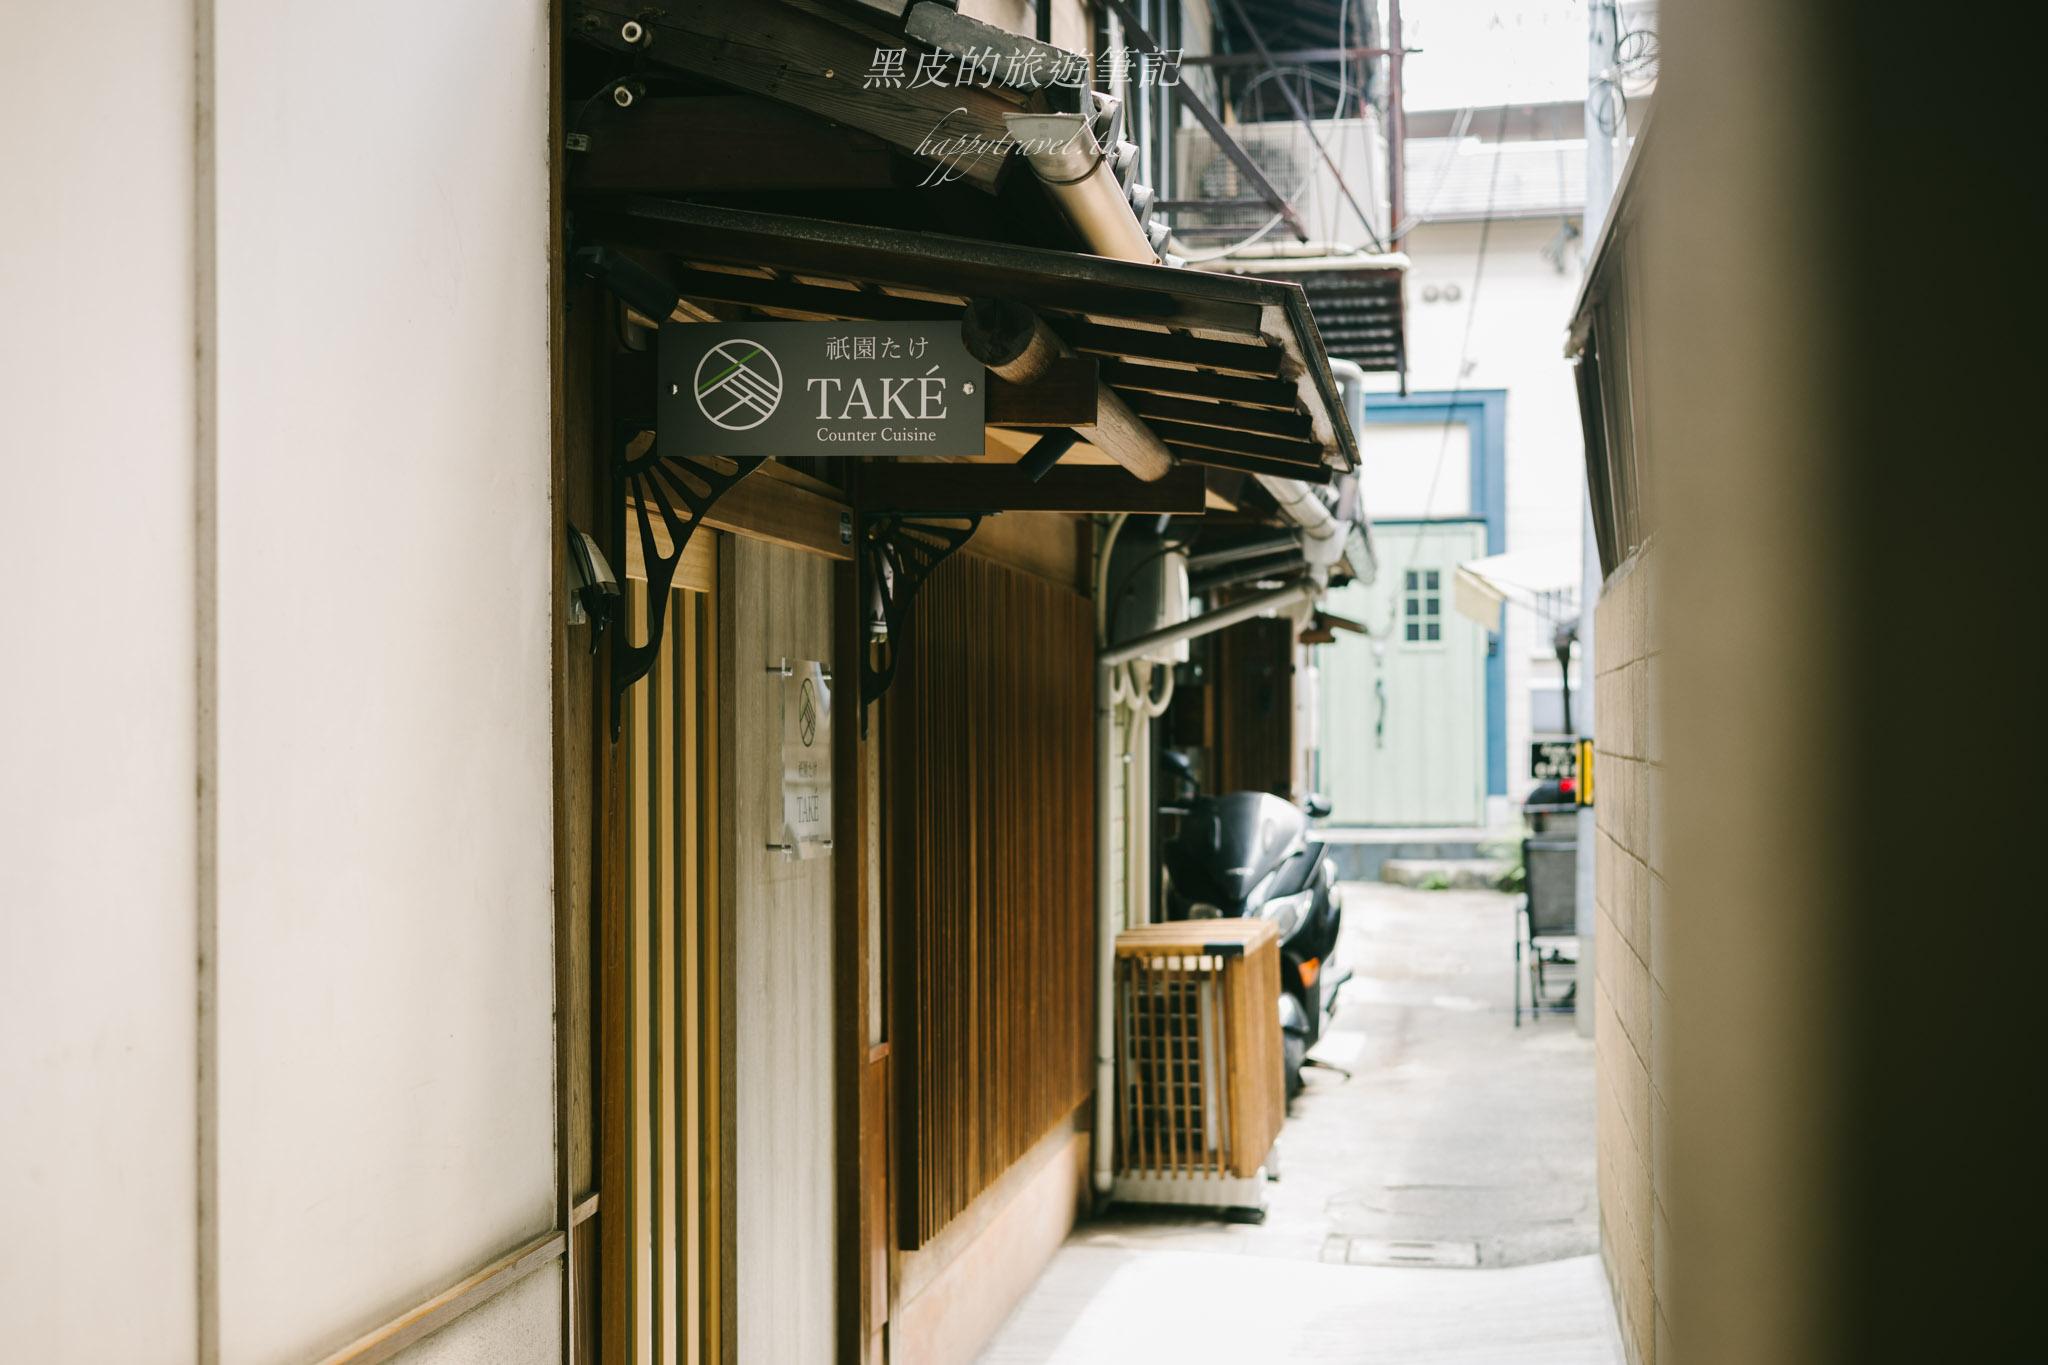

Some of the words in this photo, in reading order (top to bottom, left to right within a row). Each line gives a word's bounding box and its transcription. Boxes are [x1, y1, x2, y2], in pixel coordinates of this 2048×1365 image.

[826, 336, 928, 360] 祇園たけ
[807, 364, 947, 419] TAKÉ
[816, 427, 876, 442] Counter
[881, 427, 936, 442] Cuisine
